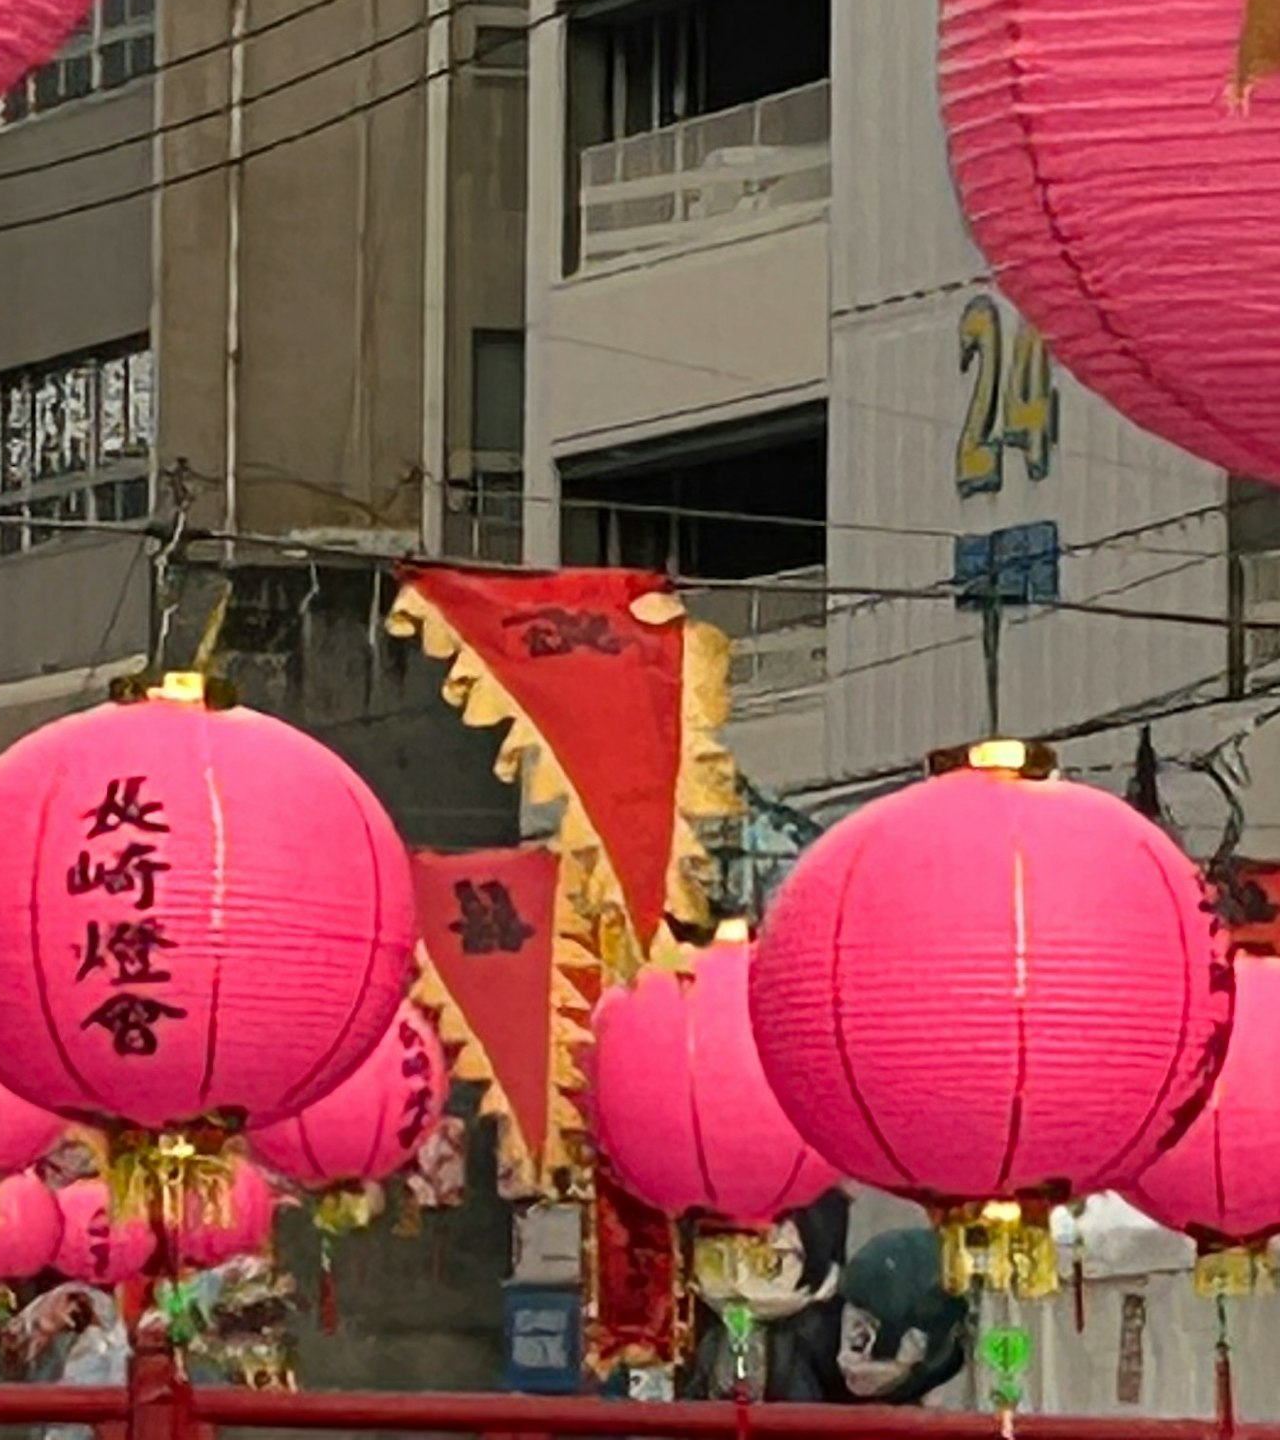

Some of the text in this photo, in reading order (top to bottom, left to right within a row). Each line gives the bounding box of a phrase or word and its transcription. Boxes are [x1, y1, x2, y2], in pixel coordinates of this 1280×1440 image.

[954, 294, 1060, 498] 24
[67, 776, 187, 1057] 長崎燈會
